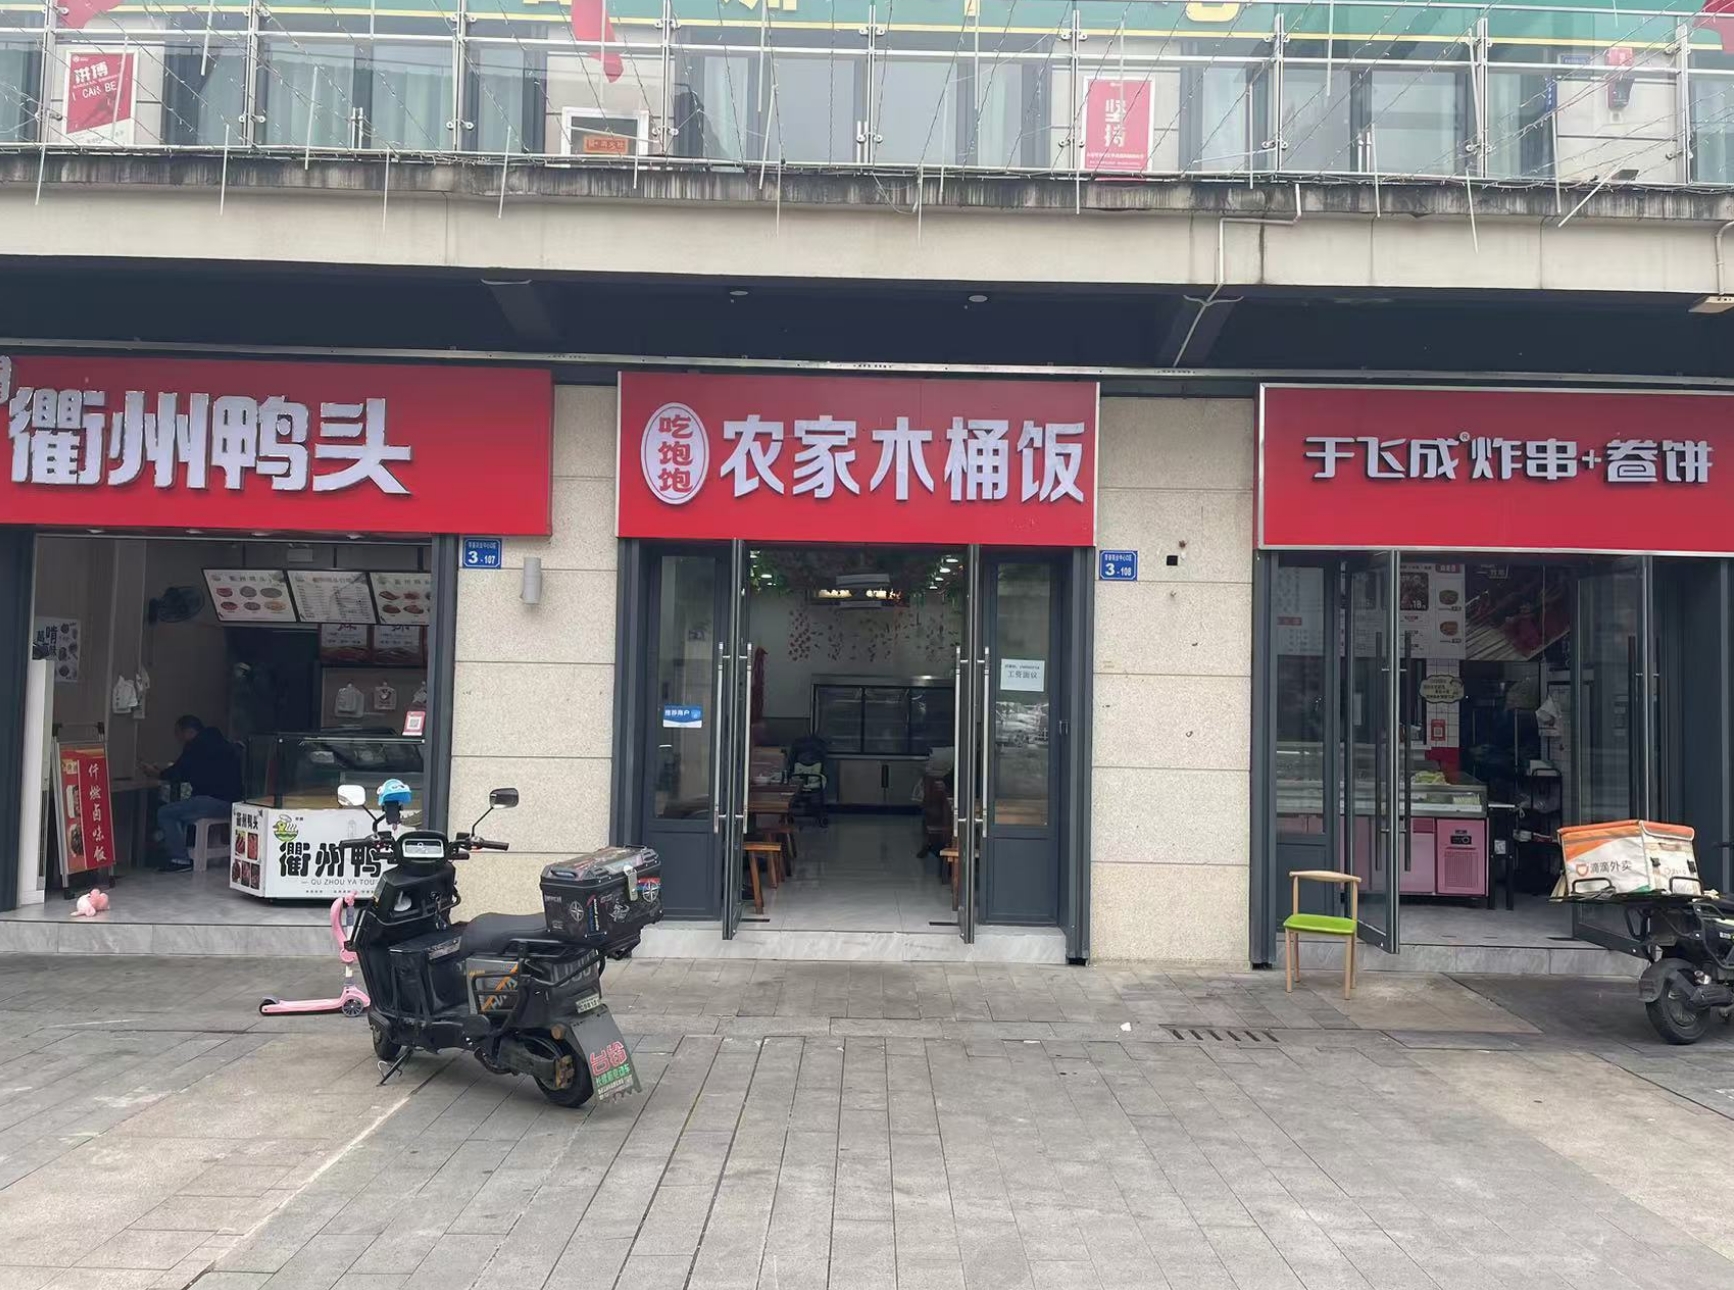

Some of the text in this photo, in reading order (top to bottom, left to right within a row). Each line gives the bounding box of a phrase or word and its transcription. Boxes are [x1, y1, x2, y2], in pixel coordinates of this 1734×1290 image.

[8, 385, 413, 495] 衢州鸭头
[658, 414, 695, 495] 吃饱饱
[719, 413, 1086, 504] 农家木桶饭
[324, 878, 346, 886] ZHOU
[347, 878, 357, 886] YA
